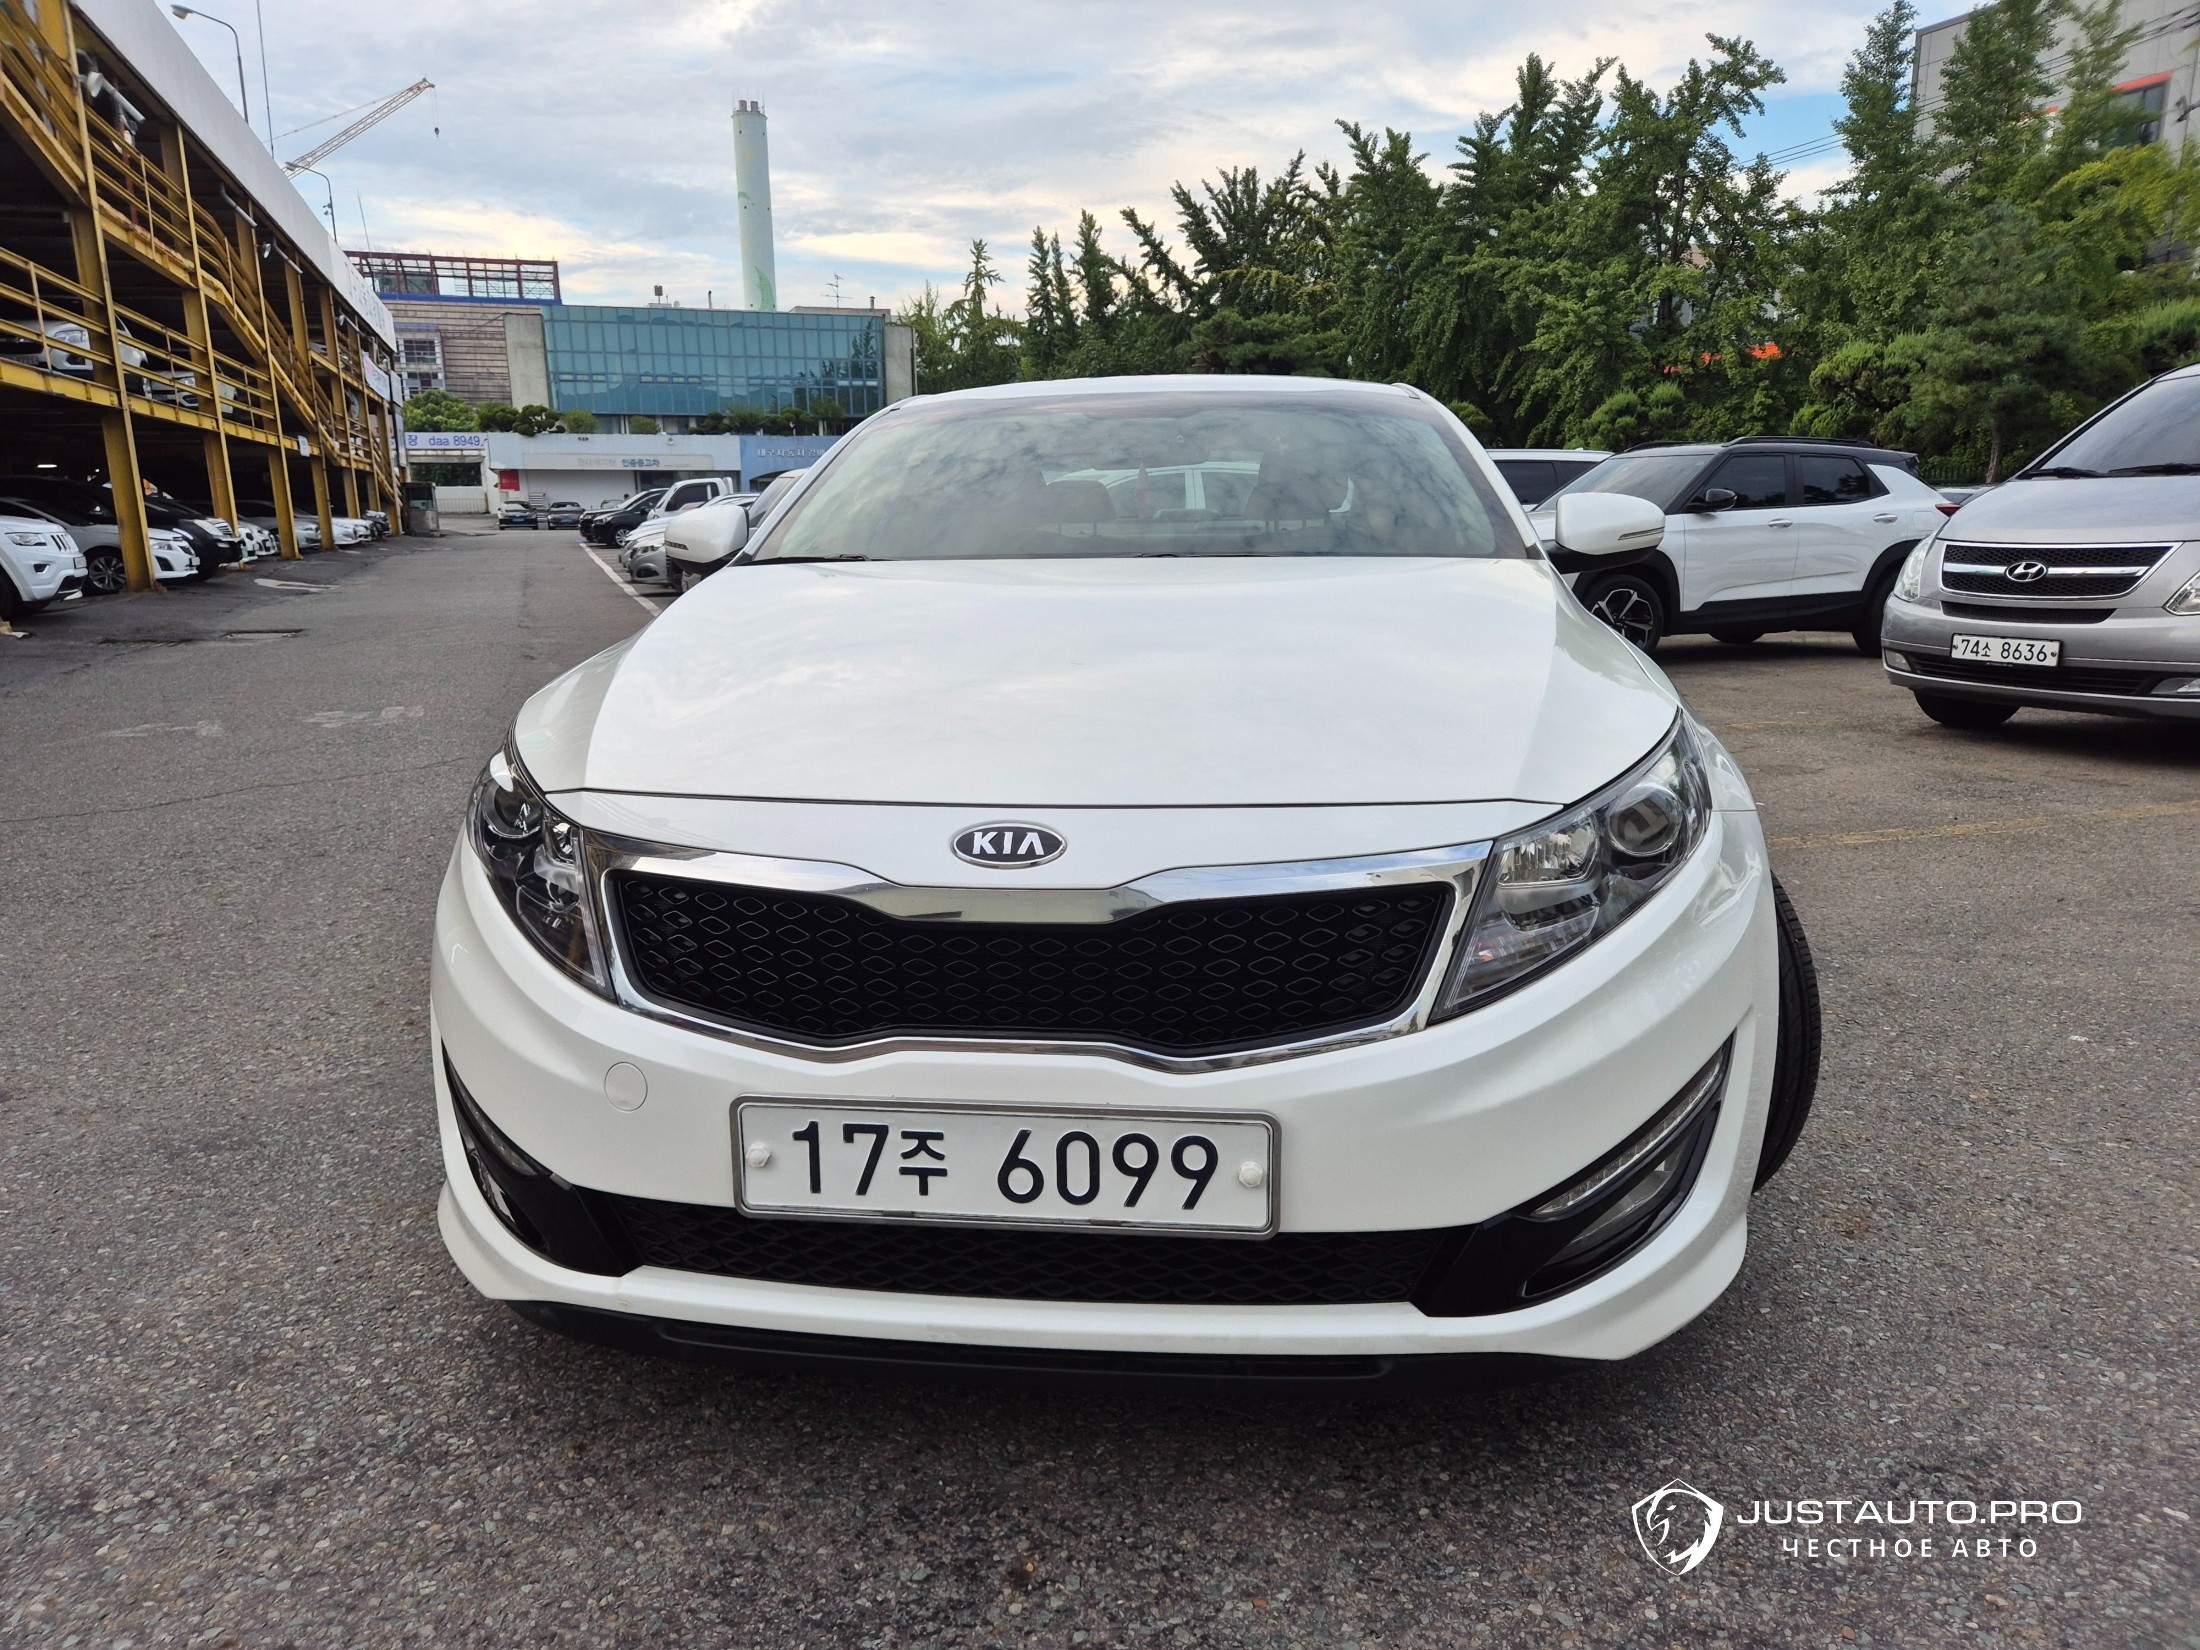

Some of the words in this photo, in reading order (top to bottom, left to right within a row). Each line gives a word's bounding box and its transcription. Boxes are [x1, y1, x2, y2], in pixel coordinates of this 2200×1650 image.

[428, 435, 449, 447] daa
[622, 458, 660, 468] 인증중고차
[1961, 639, 1992, 658] 74소
[2000, 641, 2048, 663] 8636
[972, 831, 1045, 855] KIA
[792, 1120, 948, 1196] 17주
[997, 1129, 1219, 1210] 6099
